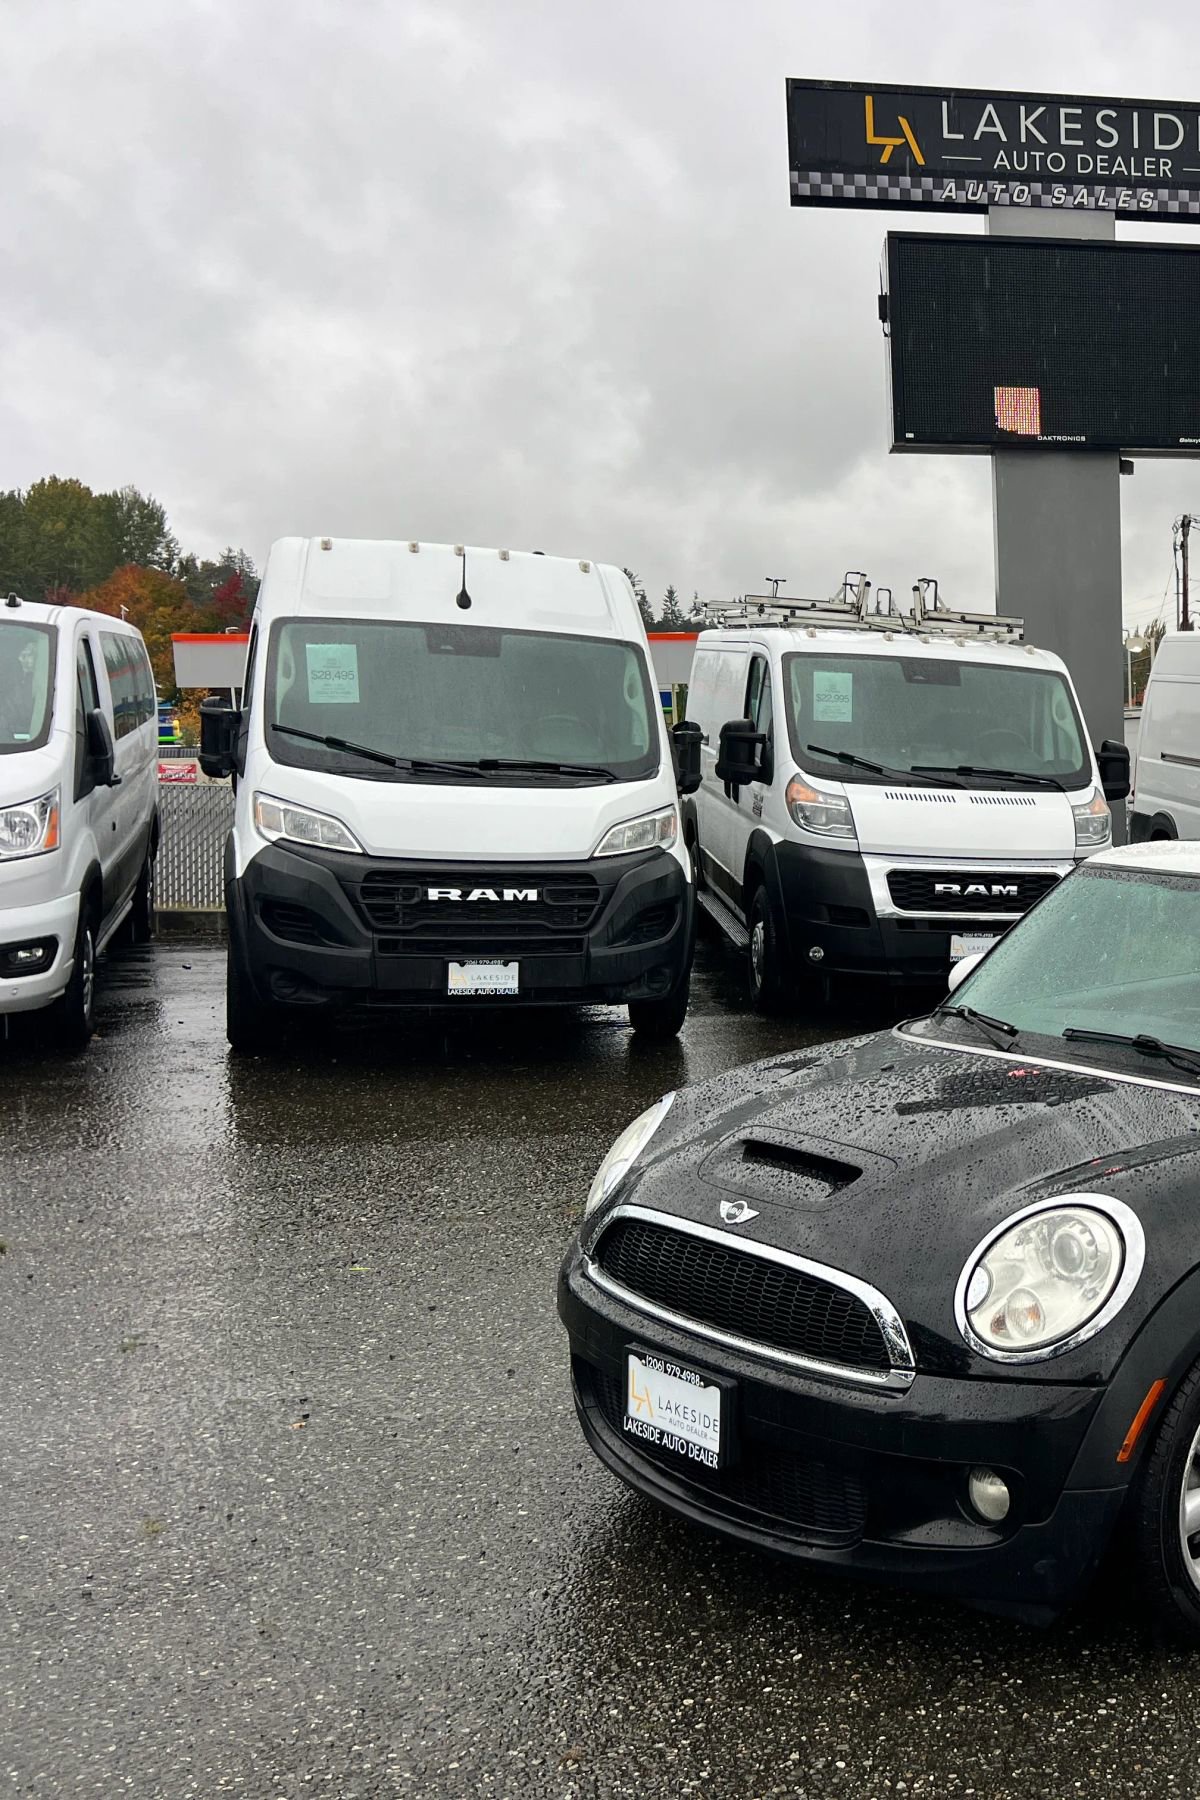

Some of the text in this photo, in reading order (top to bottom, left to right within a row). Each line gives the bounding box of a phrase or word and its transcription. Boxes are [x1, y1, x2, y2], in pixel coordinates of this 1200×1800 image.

[993, 149, 1173, 178] AUTO DEALER
[941, 181, 1155, 209] AUTO SALES
[1037, 434, 1087, 442] DAKTRONICS
[311, 670, 355, 681] $28,495
[427, 887, 538, 901] RAM
[934, 883, 1018, 896] RAM
[447, 987, 520, 996] LAKESIDE AUTO DEALER
[645, 1354, 701, 1387] (206) 979-4988
[658, 1394, 719, 1434] LAKESIDE
[668, 1417, 708, 1441] AUTO DEALER
[623, 1415, 719, 1470] LAKESIDE AUTO DEALER
